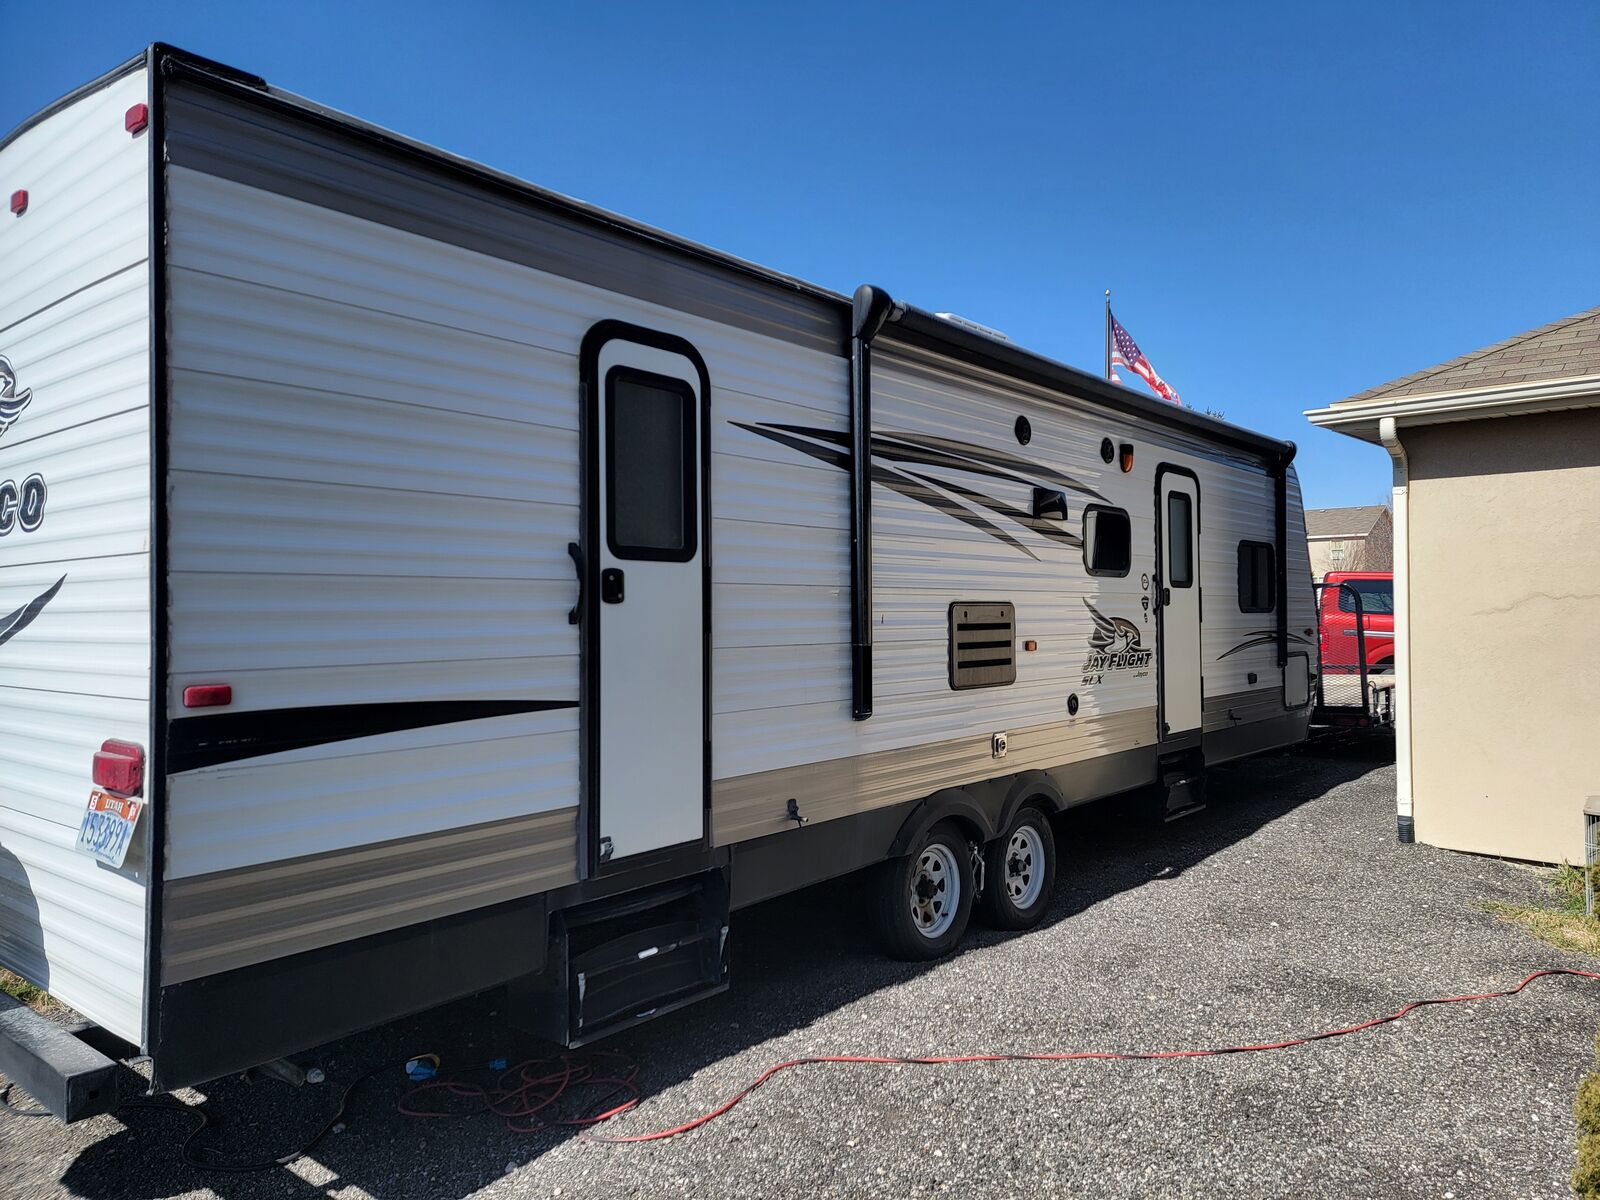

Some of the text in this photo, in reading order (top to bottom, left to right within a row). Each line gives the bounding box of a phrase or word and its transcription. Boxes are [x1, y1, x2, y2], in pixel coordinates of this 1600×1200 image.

[1082, 652, 1152, 673] JAY FLIGHT
[1080, 674, 1105, 686] SLX
[104, 798, 124, 813] UTAH
